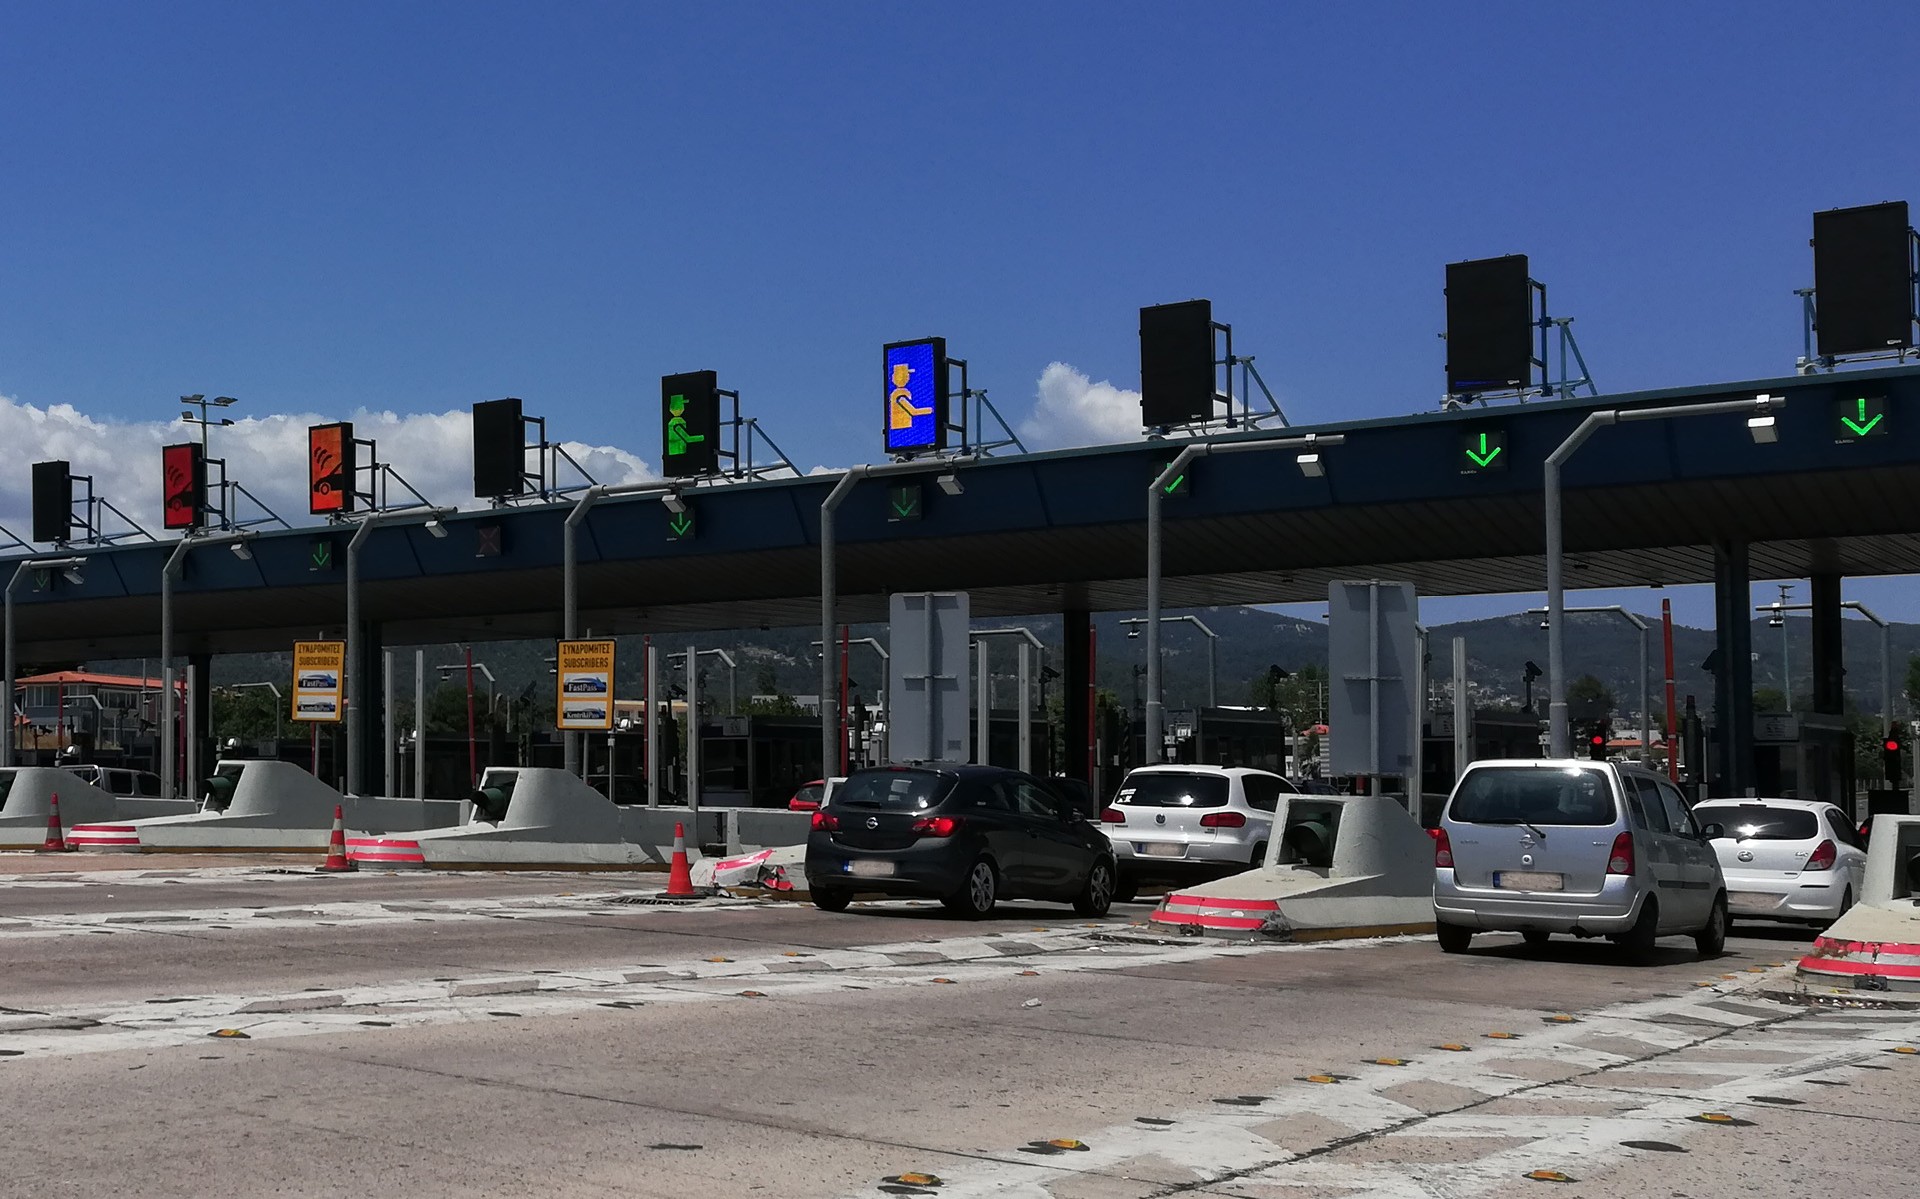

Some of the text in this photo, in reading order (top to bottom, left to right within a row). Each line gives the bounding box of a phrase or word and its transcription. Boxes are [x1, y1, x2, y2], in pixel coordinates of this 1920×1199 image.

[563, 643, 610, 654] ΣΥΝΔΡΟΜΗΤΕΣ
[299, 656, 339, 666] SUBSCRIBERS
[563, 657, 609, 668] SUBSCRIBERS
[568, 683, 598, 692] FastPass
